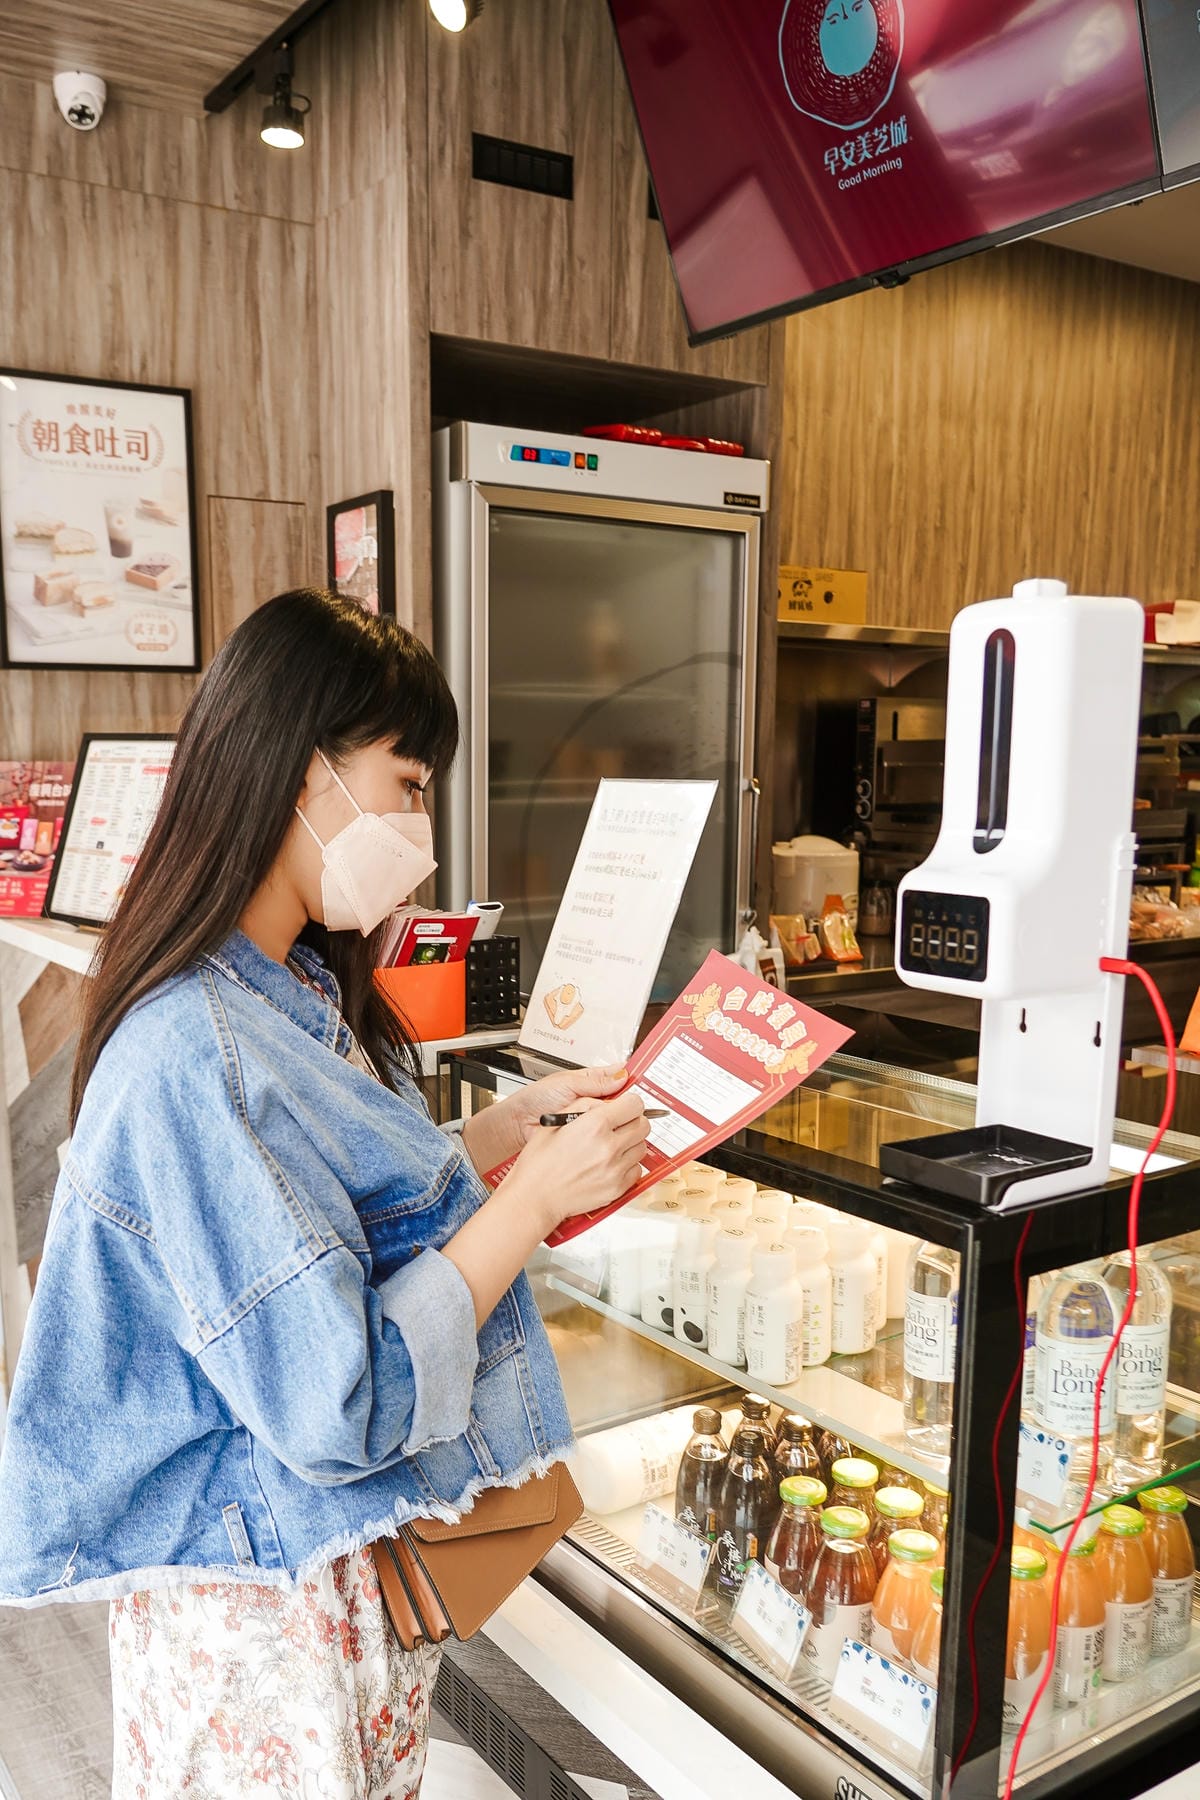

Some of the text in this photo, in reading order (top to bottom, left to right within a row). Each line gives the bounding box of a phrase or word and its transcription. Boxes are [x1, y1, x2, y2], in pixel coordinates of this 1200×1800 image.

[823, 114, 909, 176] 早安美芝城
[837, 156, 904, 191] Good Morning
[31, 418, 150, 462] 朝食吐司
[1059, 1359, 1108, 1380] Bab
